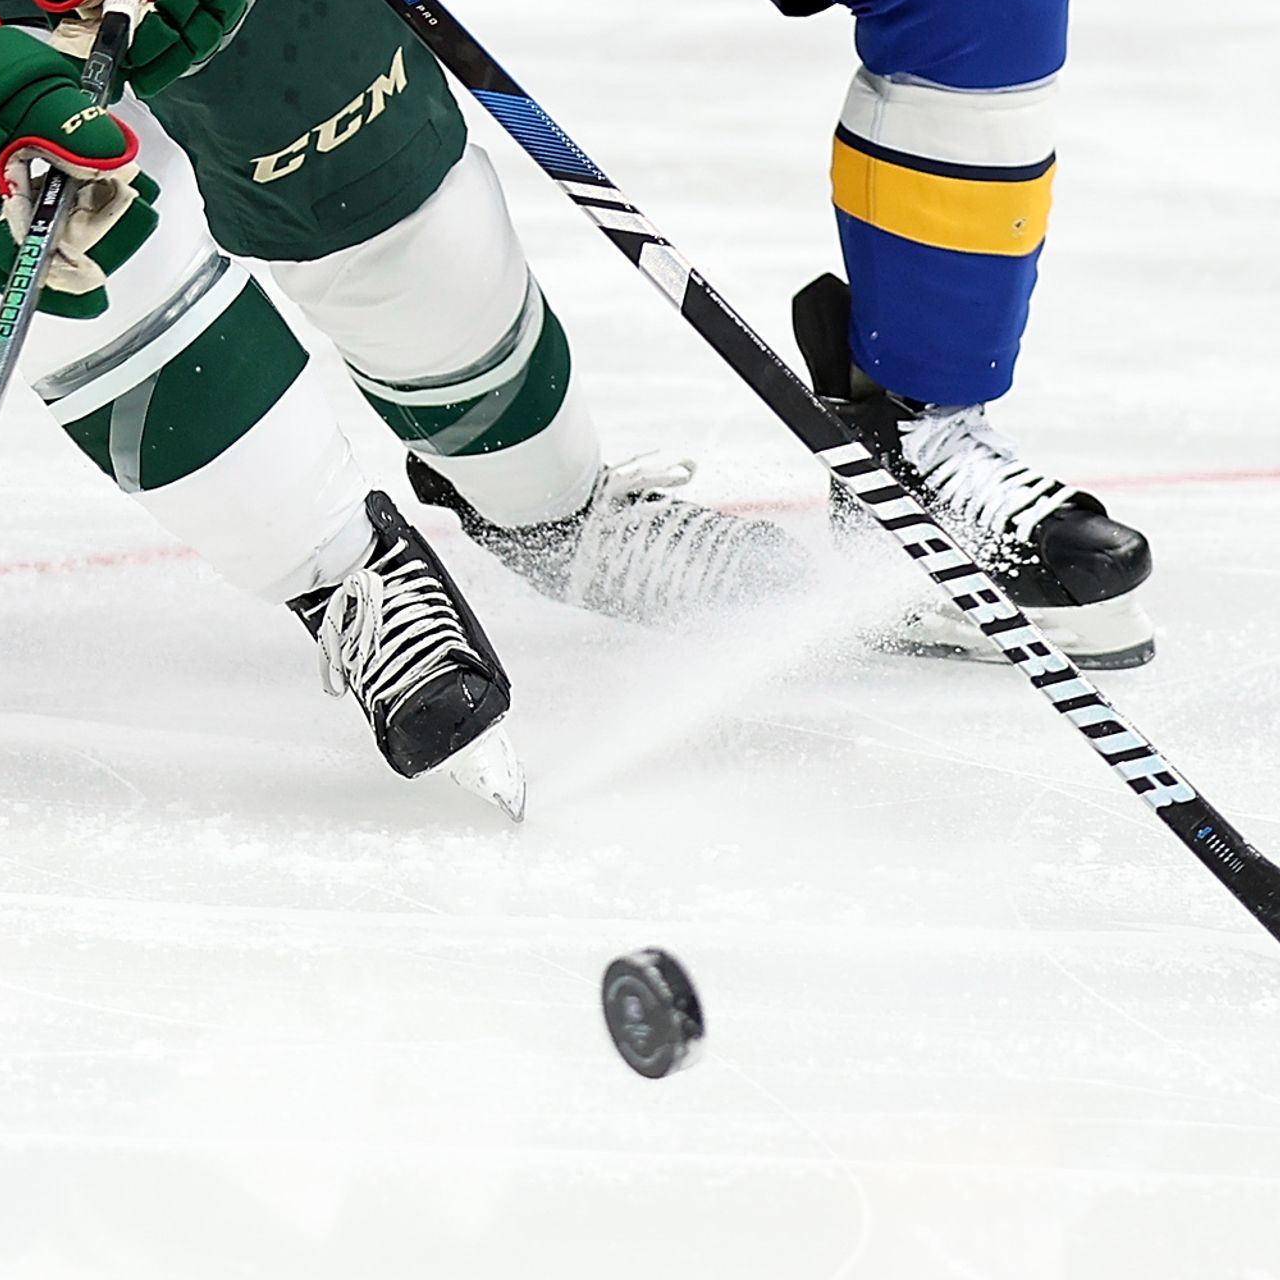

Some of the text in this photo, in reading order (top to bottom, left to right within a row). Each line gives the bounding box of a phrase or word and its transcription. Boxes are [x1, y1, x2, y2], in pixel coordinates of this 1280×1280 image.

[415, 4, 439, 26] PRO
[249, 45, 408, 184] CCM
[818, 441, 1198, 810] WARRIOR
